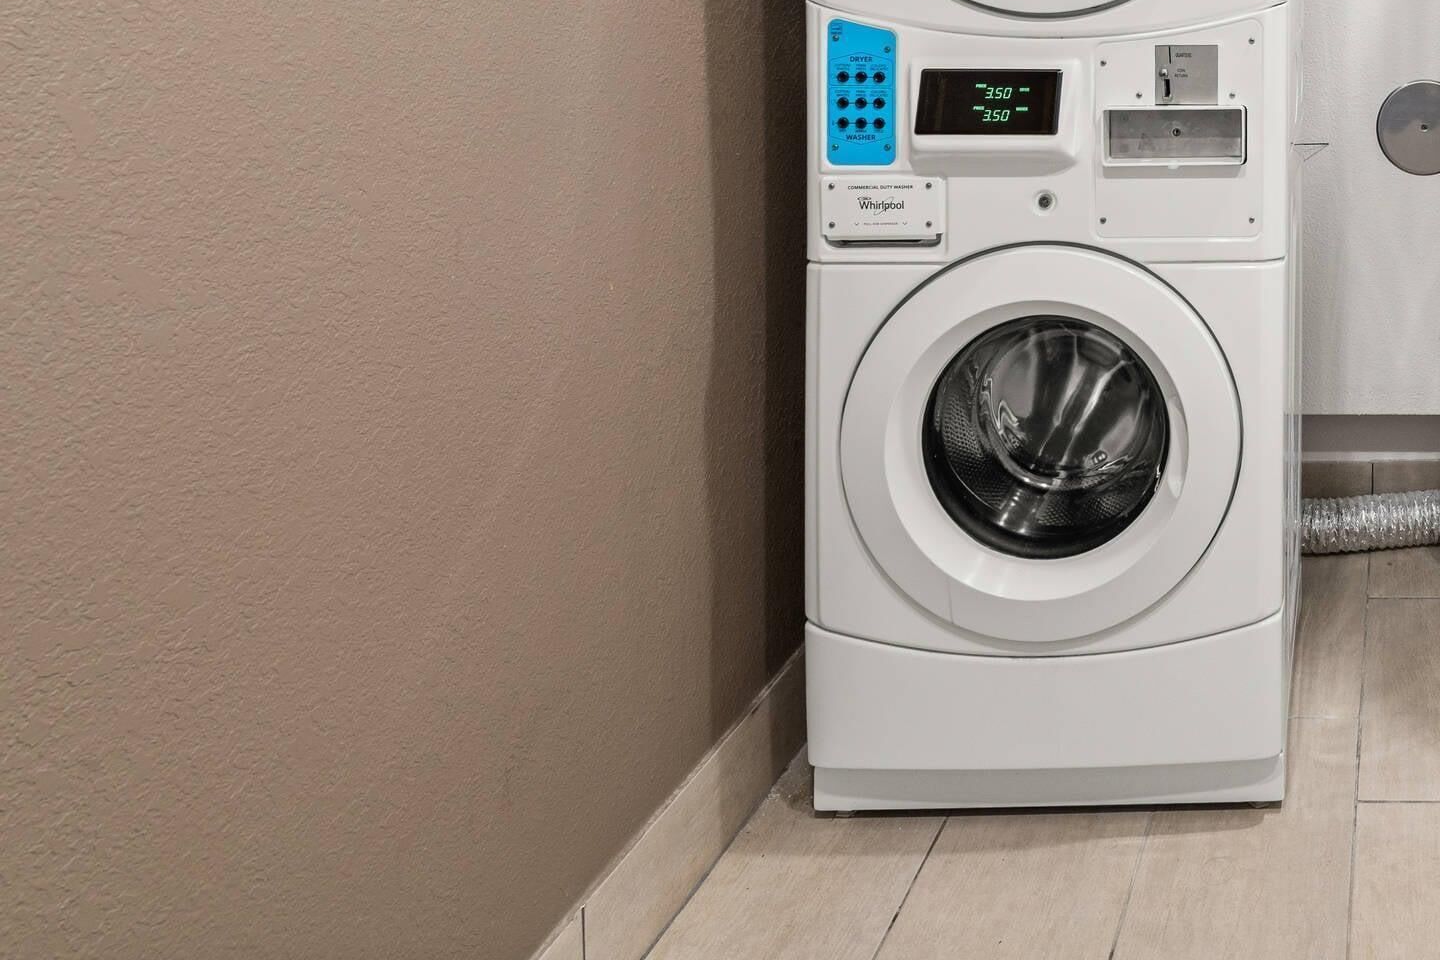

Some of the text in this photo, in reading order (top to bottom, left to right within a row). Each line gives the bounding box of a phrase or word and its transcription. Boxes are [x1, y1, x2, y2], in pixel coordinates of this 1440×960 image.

[985, 87, 1012, 99] 3.50
[982, 109, 1010, 122] 3.50
[859, 200, 905, 212] Whirlpool
